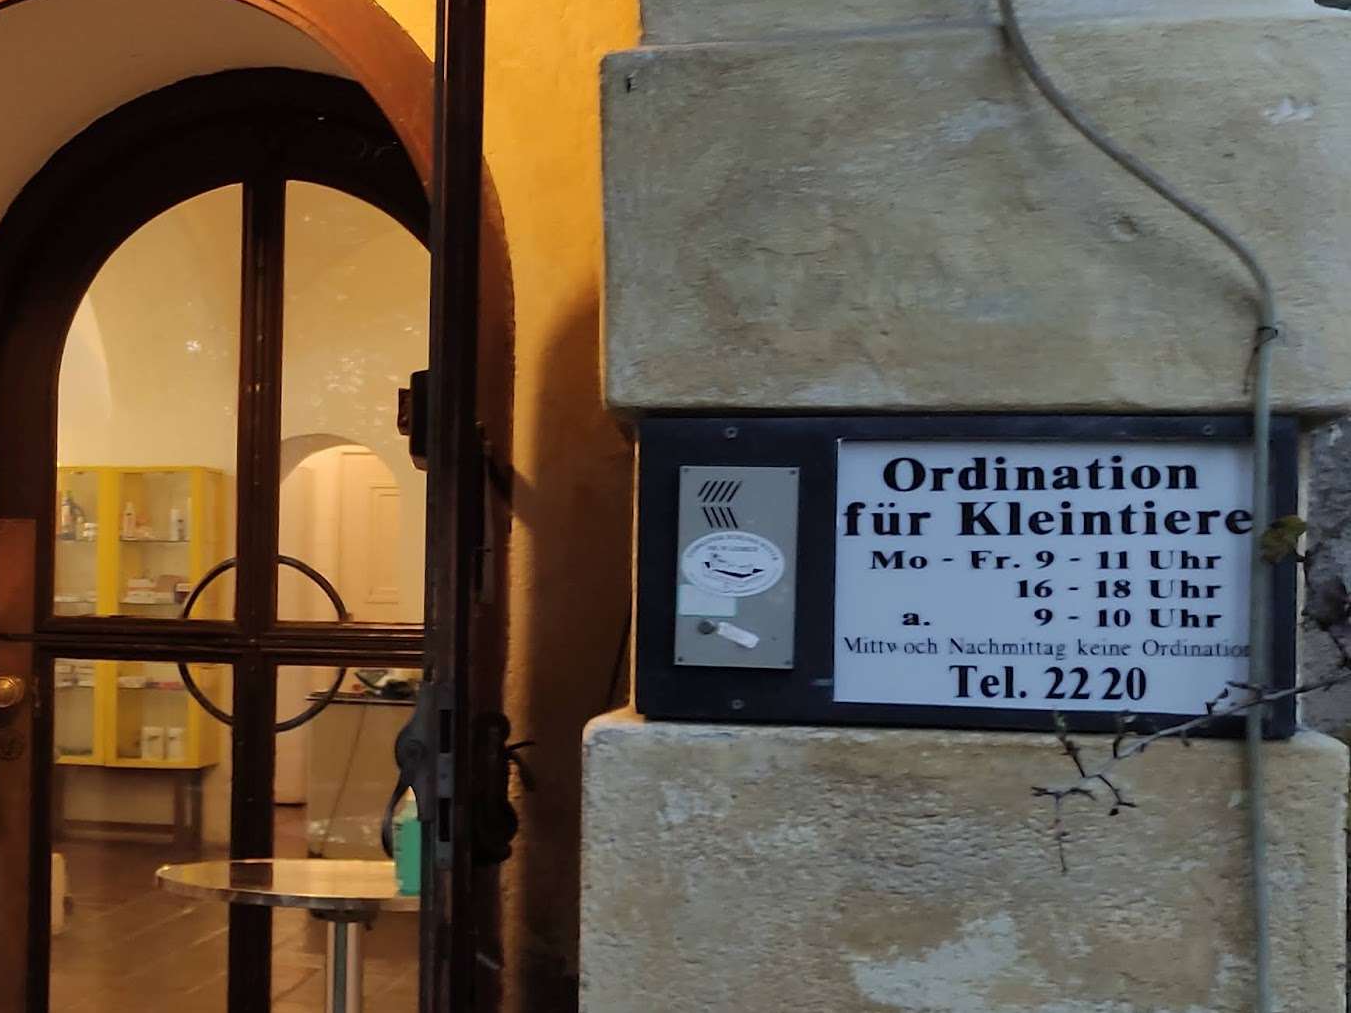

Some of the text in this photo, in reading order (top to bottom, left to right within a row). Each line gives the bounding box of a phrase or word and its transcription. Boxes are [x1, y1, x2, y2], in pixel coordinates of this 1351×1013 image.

[883, 455, 1198, 492] Ordination
[843, 500, 1253, 536] für Kleintiere
[869, 550, 928, 570] Mo
[969, 549, 1021, 570] Fr.
[1035, 550, 1055, 570] 9
[1097, 550, 1130, 570] 11
[1150, 550, 1222, 570] Uhr
[1016, 579, 1053, 599] 16
[1097, 579, 1131, 599] 18
[1150, 579, 1222, 599] Uhr
[902, 611, 931, 627] a.
[1034, 608, 1053, 627] 9
[1097, 608, 1131, 628] 10
[1150, 608, 1222, 628] Uhr
[950, 637, 1066, 660] Nachmittag
[1078, 639, 1132, 656] keine
[949, 664, 1027, 699] Tel.
